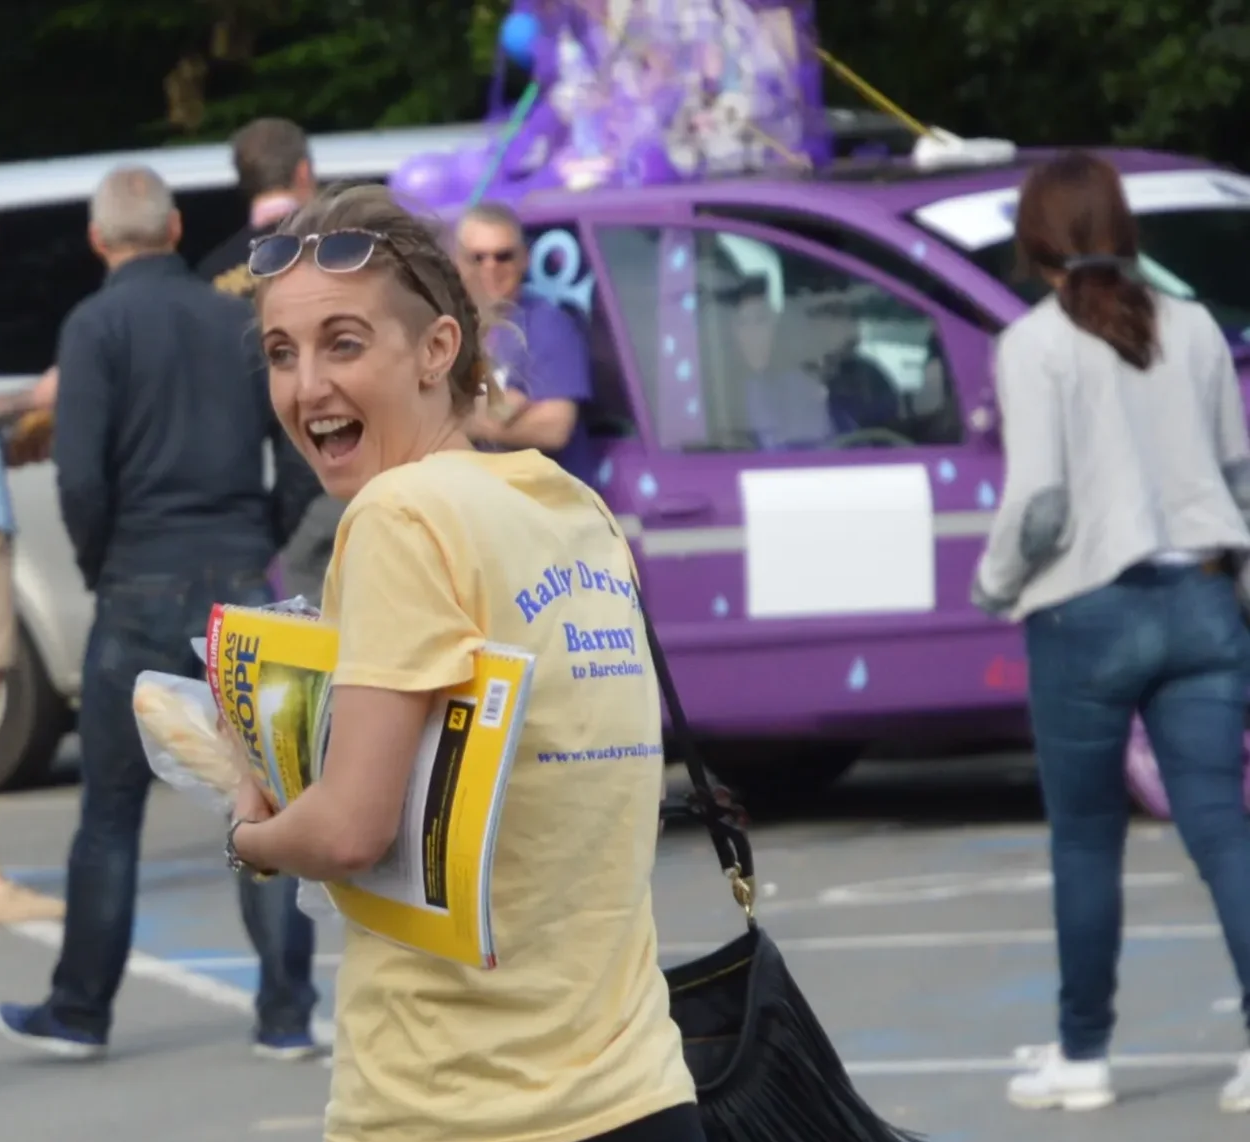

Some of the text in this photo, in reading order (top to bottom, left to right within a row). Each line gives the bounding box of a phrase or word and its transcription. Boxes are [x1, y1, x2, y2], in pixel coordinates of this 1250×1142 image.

[515, 564, 573, 623] Rally
[209, 617, 223, 669] EUROPE
[562, 622, 636, 655] Barmy
[224, 632, 237, 703] ATLAS
[571, 664, 587, 680] to
